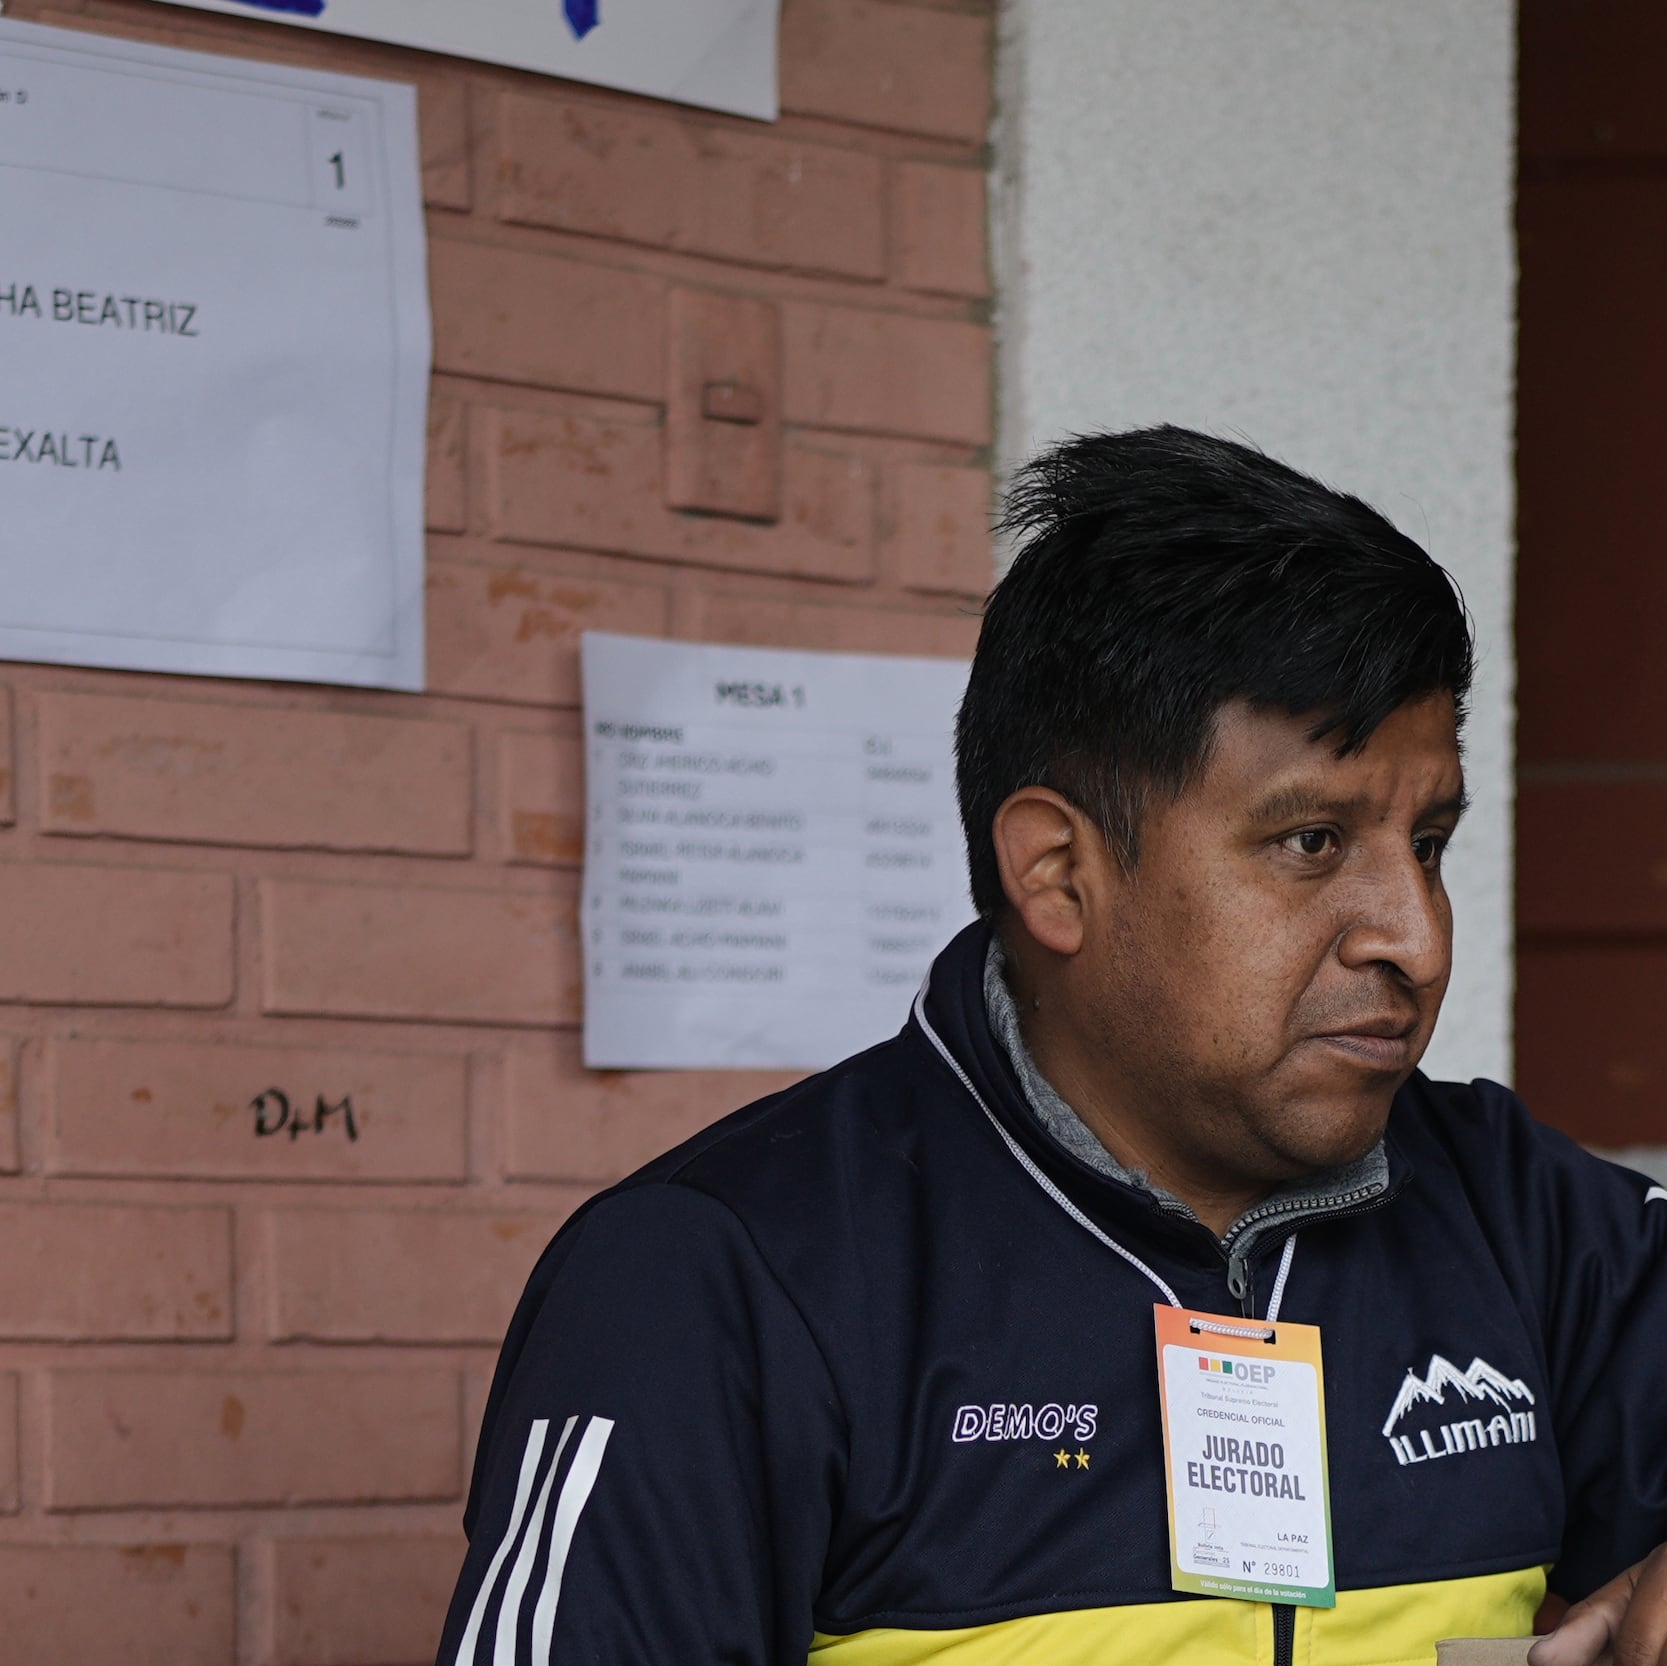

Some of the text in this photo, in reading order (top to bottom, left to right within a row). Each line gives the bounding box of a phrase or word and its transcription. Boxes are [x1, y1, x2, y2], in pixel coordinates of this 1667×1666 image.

[328, 150, 345, 190] 1
[52, 288, 199, 338] BEATRIZ
[1234, 1363, 1276, 1384] OEP
[952, 1403, 1098, 1442] DEMO'S
[1197, 1407, 1286, 1428] CREDENCIAL OFICIAL
[1202, 1434, 1285, 1469] JURADO
[1187, 1461, 1306, 1501] ELECTORAL
[1277, 1533, 1309, 1544] LA PAZ
[1264, 1562, 1300, 1578] 29801
